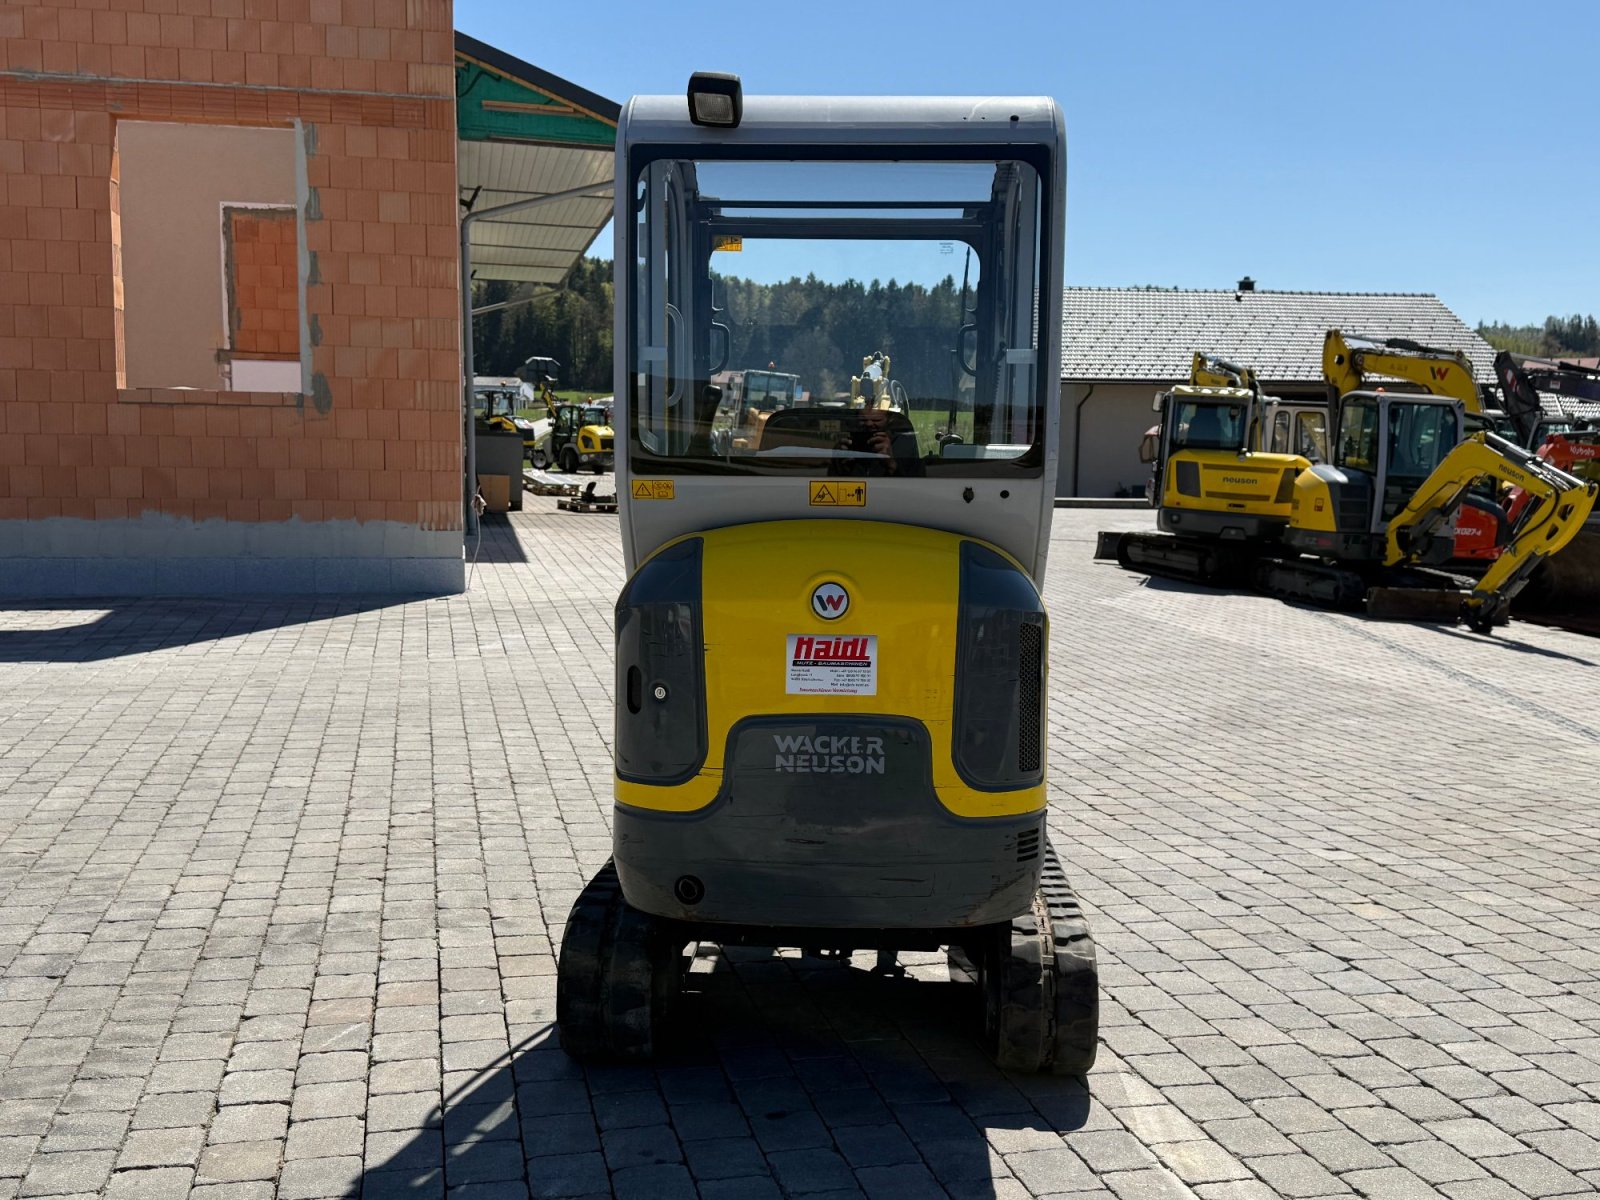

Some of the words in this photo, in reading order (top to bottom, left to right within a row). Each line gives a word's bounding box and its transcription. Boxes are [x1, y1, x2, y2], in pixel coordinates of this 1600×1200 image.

[1222, 476, 1258, 485] neuson
[1499, 463, 1525, 481] neuson
[816, 594, 845, 611] W
[773, 734, 885, 755] WACKER
[775, 754, 885, 774] NEUSON
